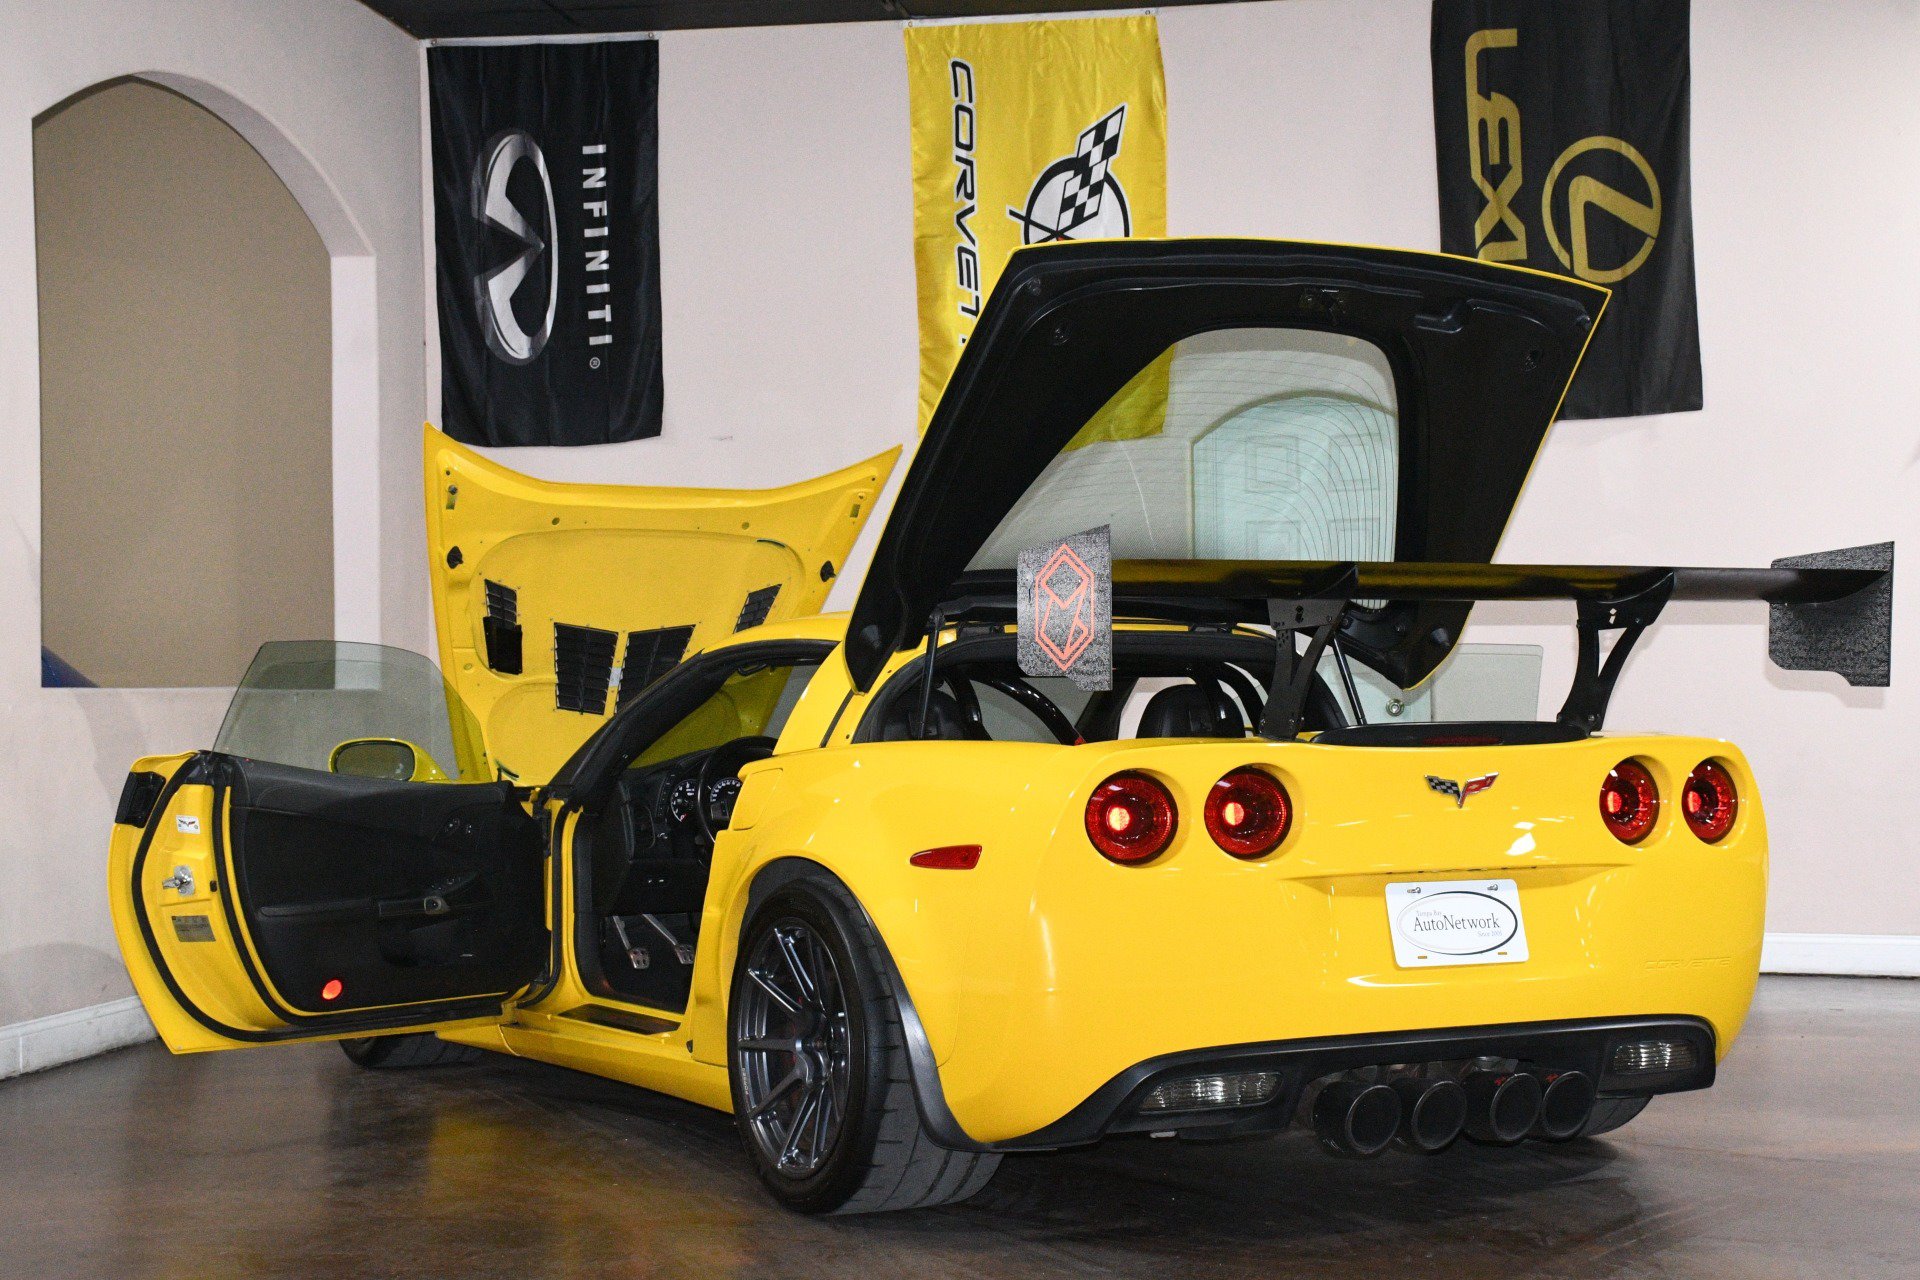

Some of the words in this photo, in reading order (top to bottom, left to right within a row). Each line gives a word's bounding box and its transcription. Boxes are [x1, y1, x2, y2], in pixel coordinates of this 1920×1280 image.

[582, 144, 613, 346] INFINITI
[950, 59, 981, 345] CORVET
[1413, 912, 1500, 932] AutoNetwork
